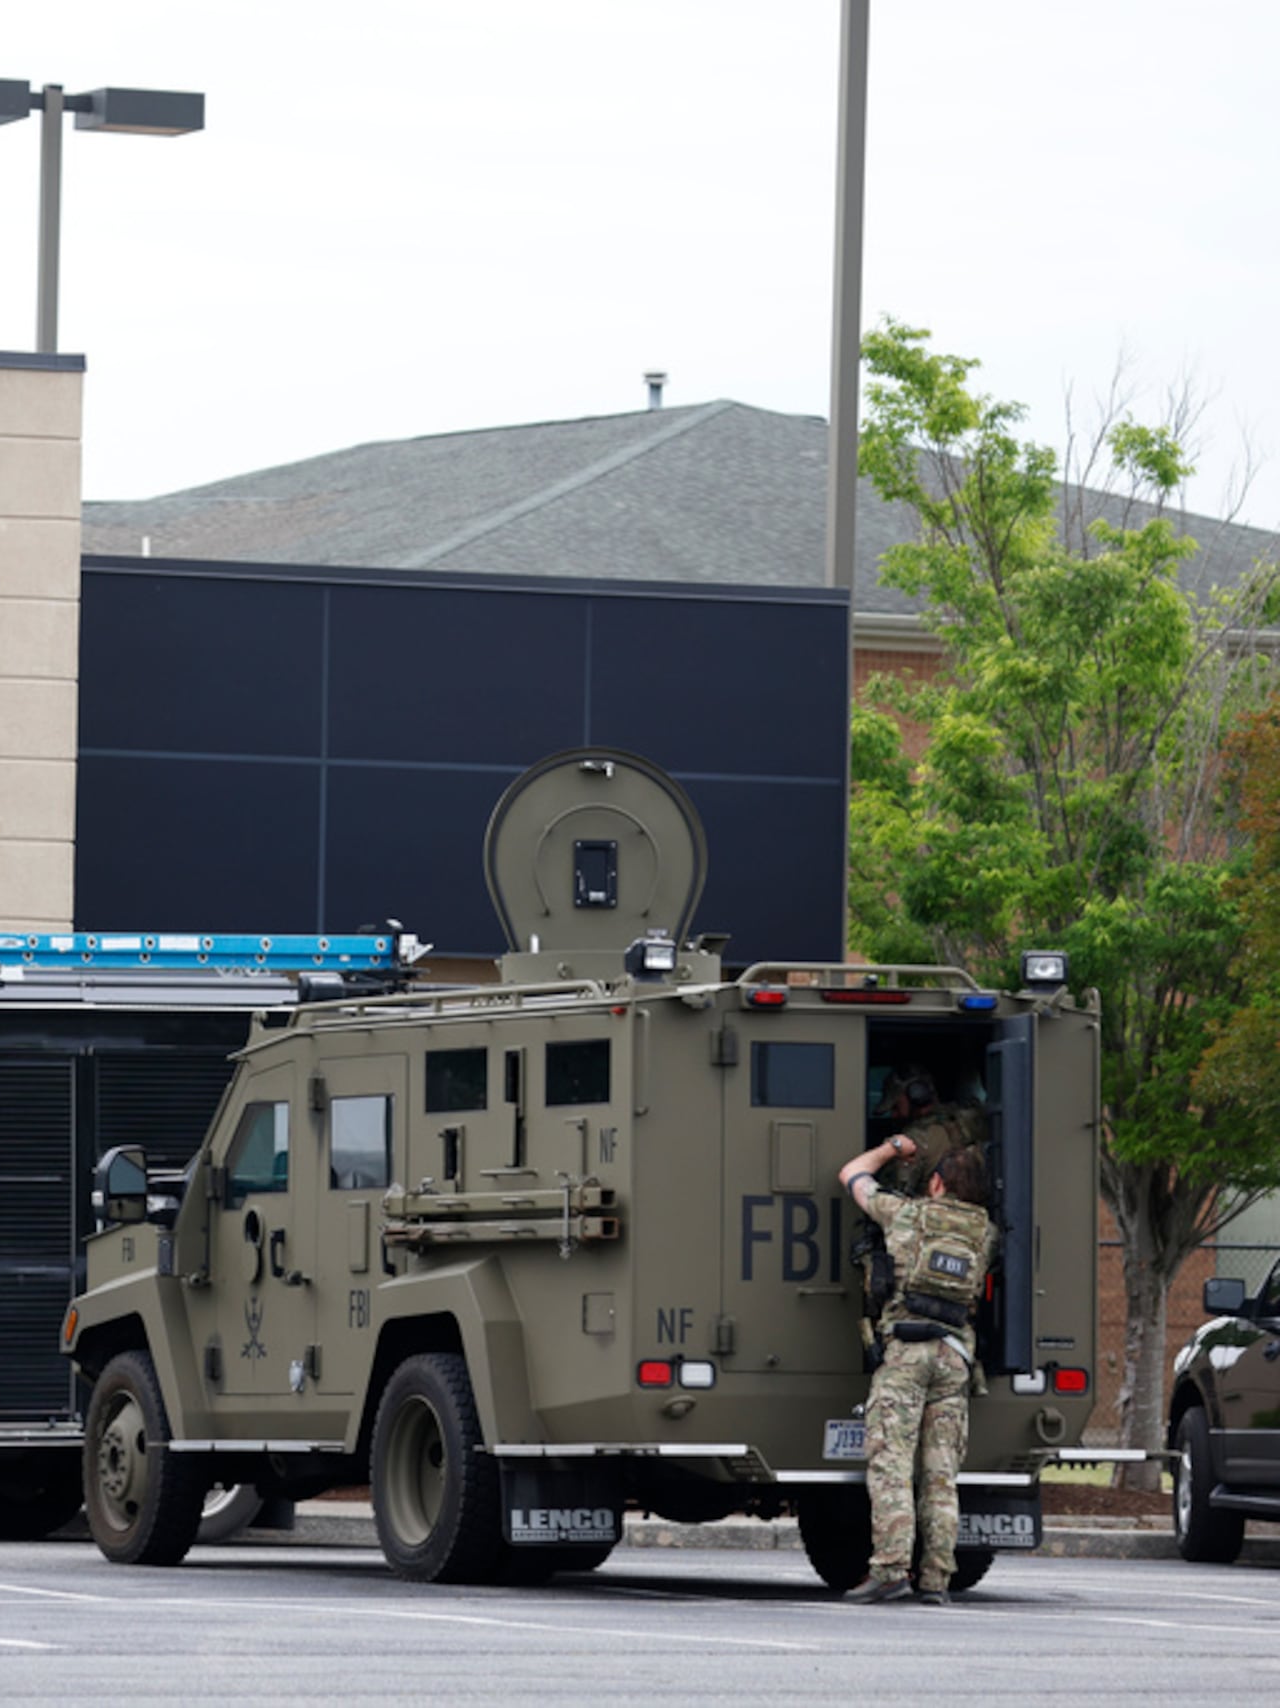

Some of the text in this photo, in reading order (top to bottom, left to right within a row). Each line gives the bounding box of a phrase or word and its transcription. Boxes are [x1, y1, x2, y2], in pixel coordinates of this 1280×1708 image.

[599, 1128, 618, 1164] NF
[741, 1195, 842, 1283] FBI
[936, 1255, 962, 1274] FBI
[349, 1290, 370, 1328] FBI
[657, 1307, 694, 1344] NF
[511, 1509, 615, 1530] LENCO
[958, 1514, 1035, 1534] ENCO
